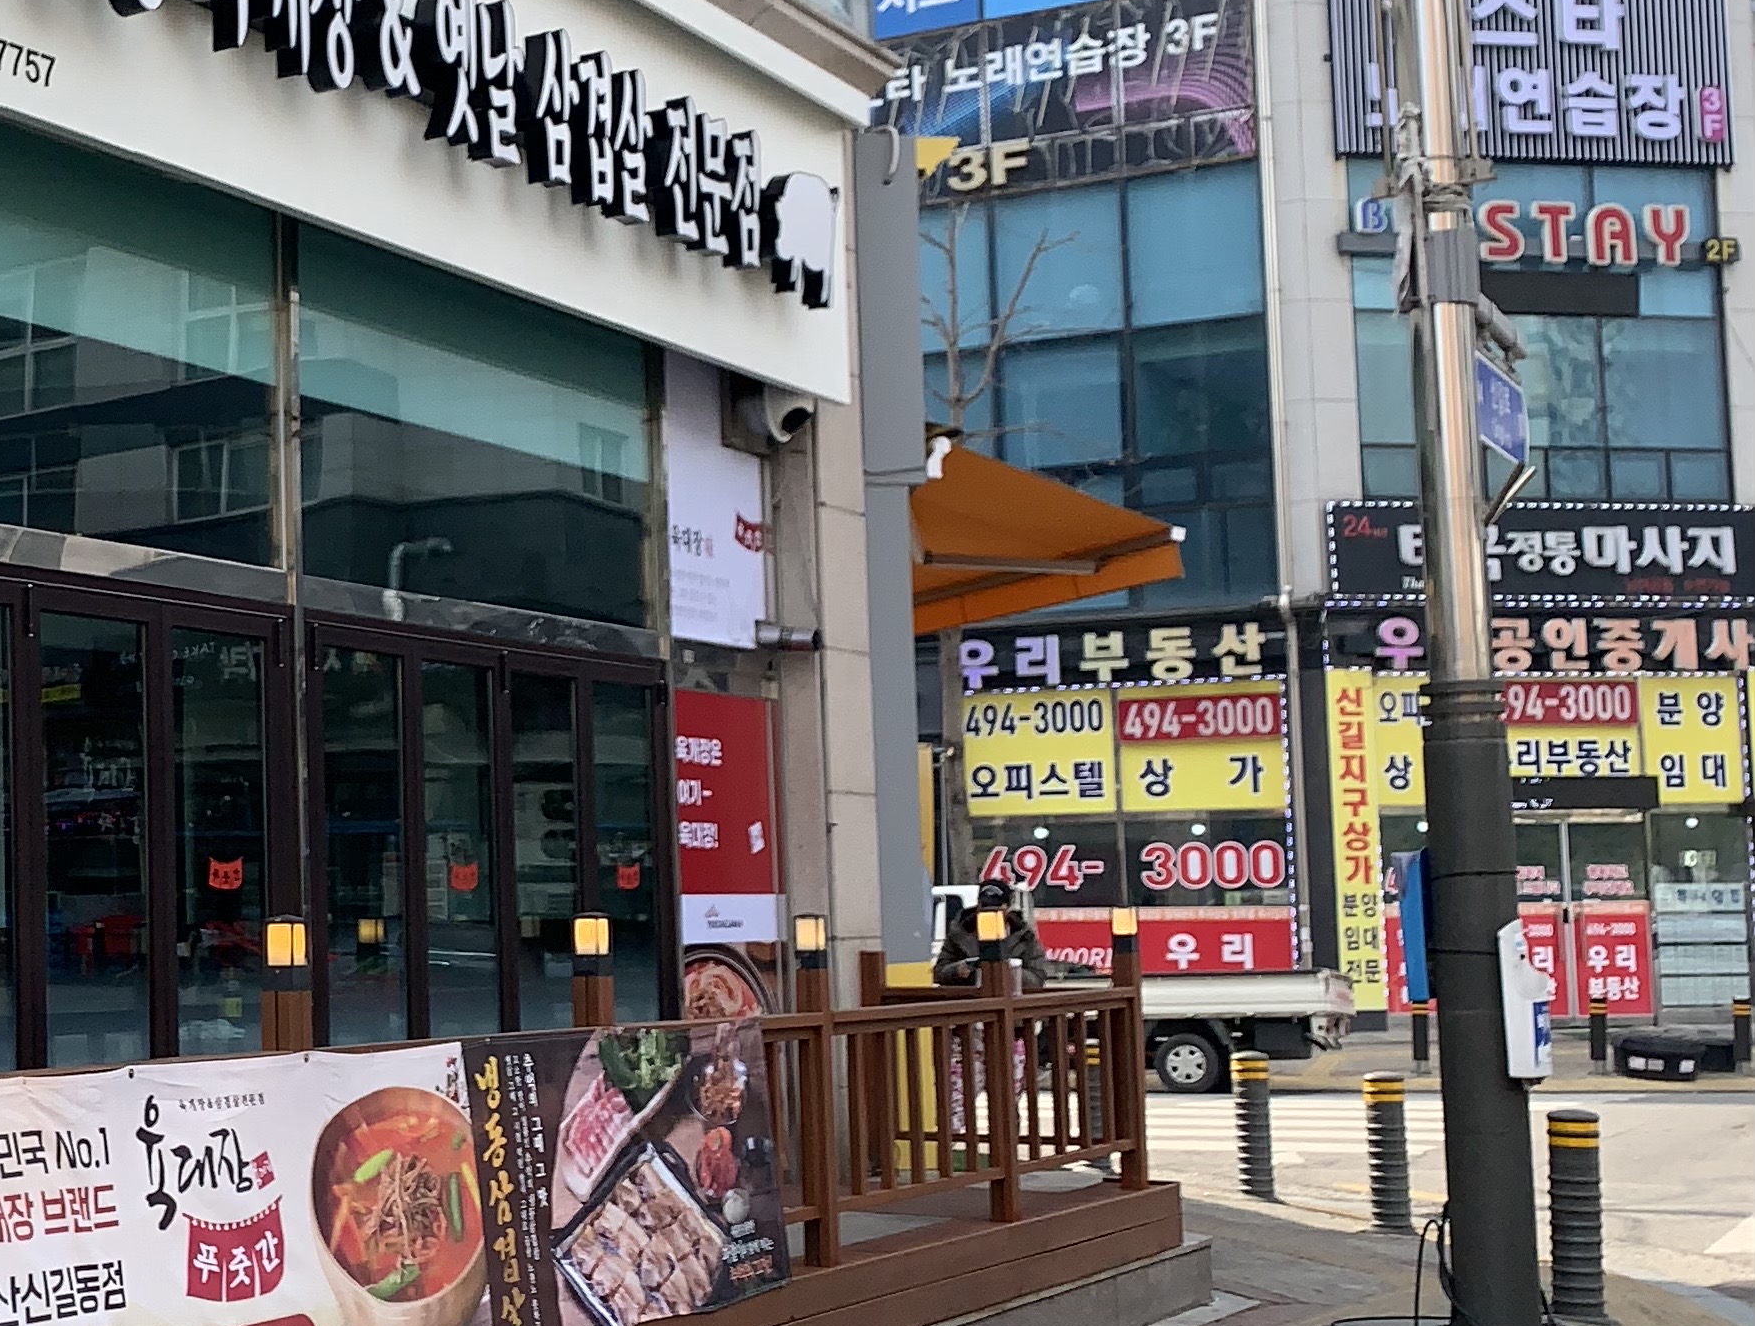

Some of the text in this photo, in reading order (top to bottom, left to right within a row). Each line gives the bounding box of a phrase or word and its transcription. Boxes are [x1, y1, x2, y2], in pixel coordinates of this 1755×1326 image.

[944, 23, 1152, 95] 노래연습장
[1164, 12, 1220, 57] 3F
[1699, 86, 1725, 141] 3F
[537, 27, 653, 226] 삼겹살
[663, 95, 763, 270] 전문점
[946, 137, 1032, 193] 3F
[1703, 238, 1739, 263] 2F
[958, 620, 1267, 690] 우리부동산
[964, 697, 1104, 737] 494-3000
[1122, 695, 1275, 739] 494-3000
[1497, 683, 1633, 723] 94-3000
[969, 760, 1106, 801] 오피스텔
[1511, 739, 1633, 778] 리부동산
[1334, 684, 1374, 886] 신길지구상가
[1164, 932, 1255, 972] 우리
[1586, 944, 1639, 974] 우리
[1587, 975, 1641, 1002] 부동산
[54, 1125, 111, 1169] No.1
[135, 1094, 258, 1232] 육대장
[41, 1182, 120, 1235] 브랜드
[191, 1230, 282, 1289] 푸줏간
